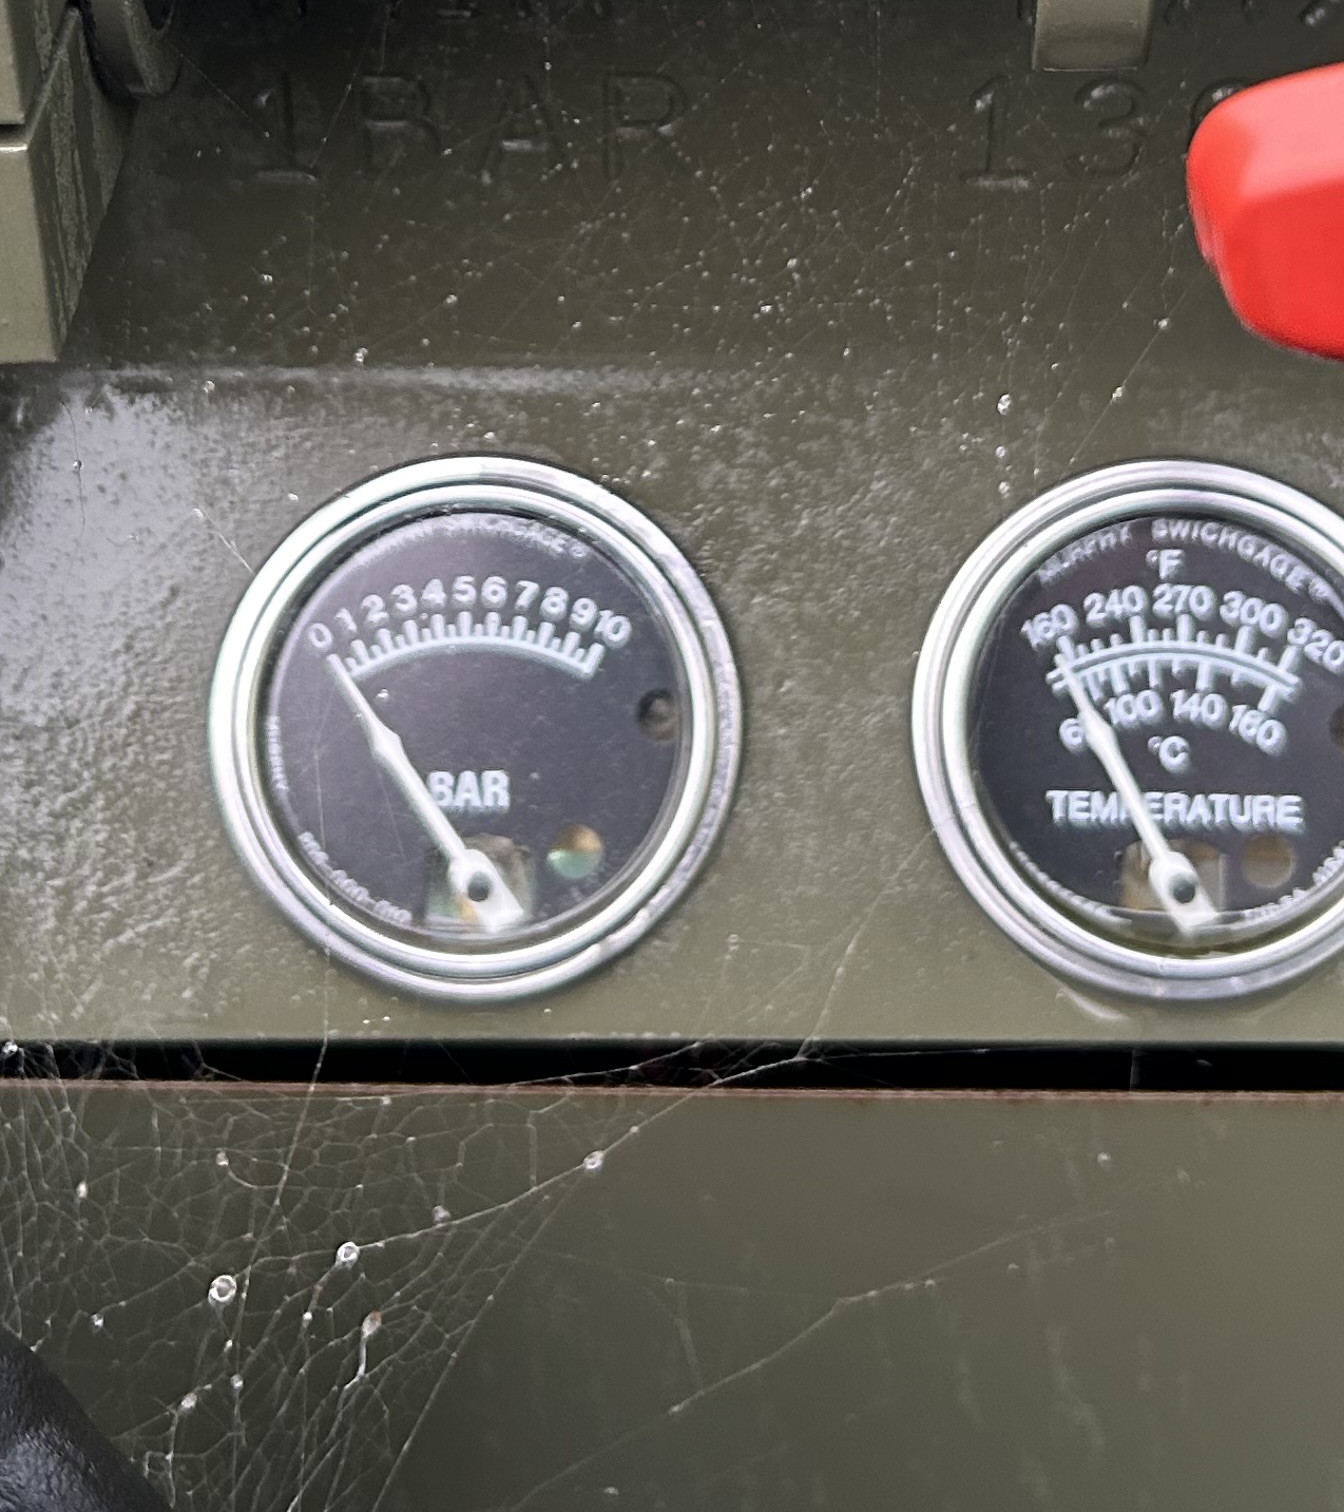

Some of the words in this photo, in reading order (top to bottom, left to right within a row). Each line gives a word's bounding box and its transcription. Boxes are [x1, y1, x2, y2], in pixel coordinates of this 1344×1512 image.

[307, 621, 334, 651] 0
[336, 607, 357, 633] 1
[360, 593, 389, 627] 2
[390, 583, 418, 617] 3
[421, 578, 447, 610] 4
[453, 575, 478, 610] 5
[481, 575, 508, 610] 6
[515, 579, 540, 612] 7
[540, 586, 570, 622] 8
[569, 596, 598, 632] 9
[594, 608, 633, 648] 10
[1020, 602, 1079, 652] 160
[1083, 584, 1149, 628] 240
[1153, 584, 1215, 621] 270
[1220, 590, 1290, 639] 300
[1103, 689, 1164, 732] 100
[1170, 688, 1231, 730] 140
[426, 769, 511, 810] BAR
[1045, 789, 1306, 831] TEMERATURE
